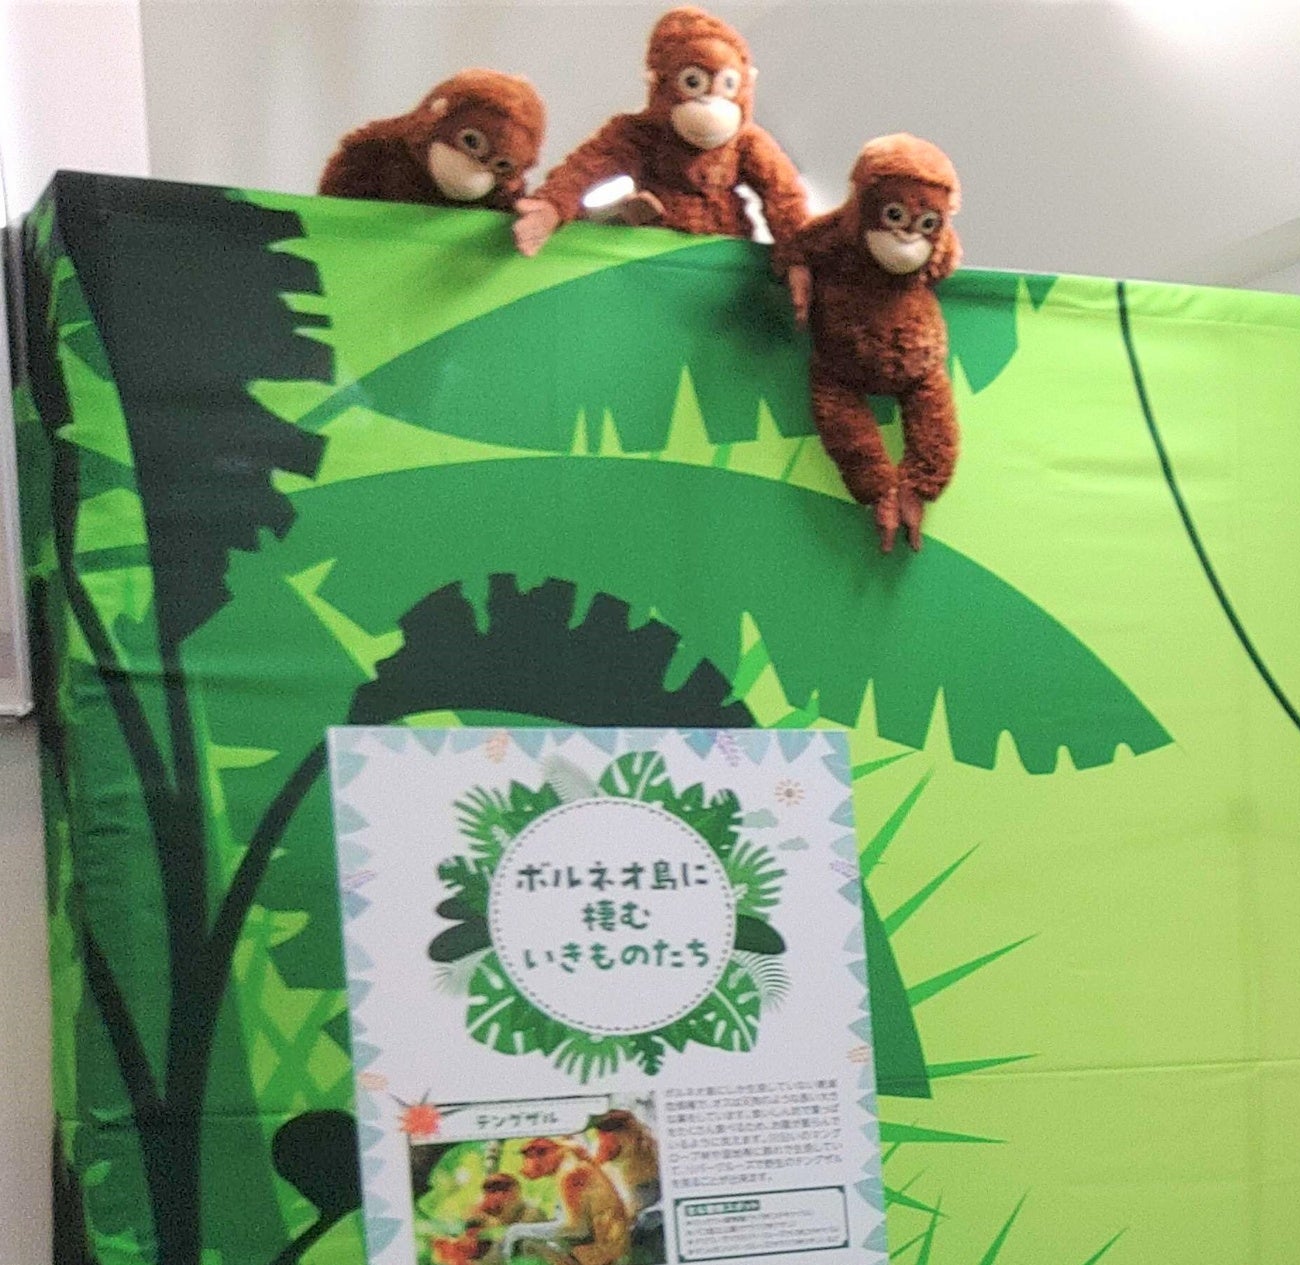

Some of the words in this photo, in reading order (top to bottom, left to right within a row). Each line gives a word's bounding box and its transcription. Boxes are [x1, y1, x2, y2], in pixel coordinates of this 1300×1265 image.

[516, 857, 709, 893] ボルネオ島に
[582, 899, 651, 932] 棲む
[522, 938, 710, 974] いきものたち
[475, 1110, 560, 1130] テングザル
